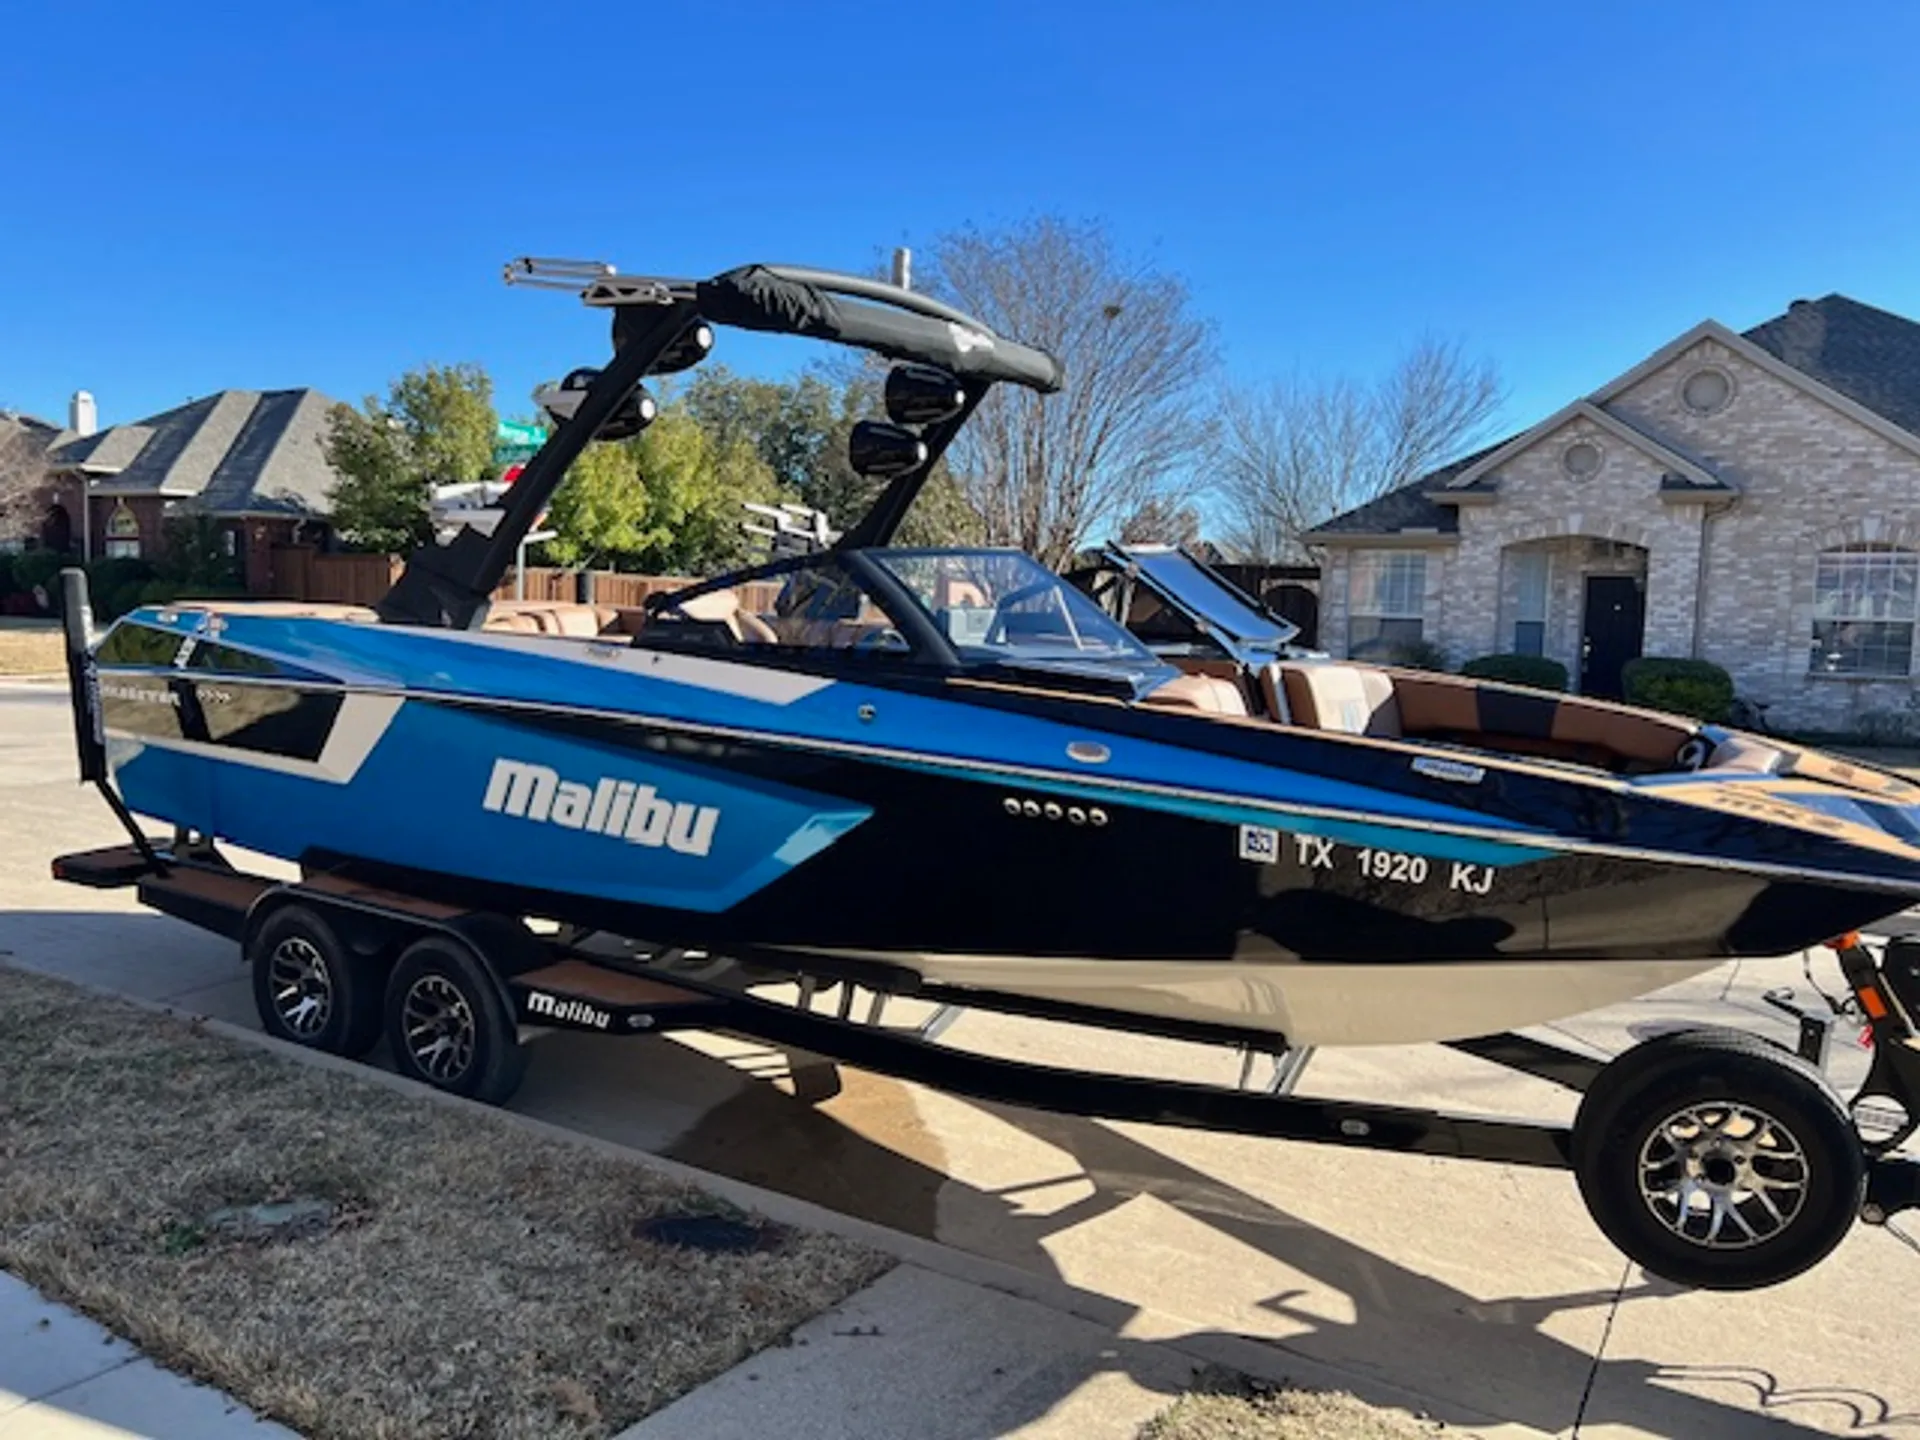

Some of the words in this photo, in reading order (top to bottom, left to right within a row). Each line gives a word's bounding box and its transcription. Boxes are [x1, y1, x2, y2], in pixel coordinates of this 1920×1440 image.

[1294, 833, 1335, 869] TX
[1357, 848, 1427, 884] 1920
[1450, 862, 1494, 894] KJ
